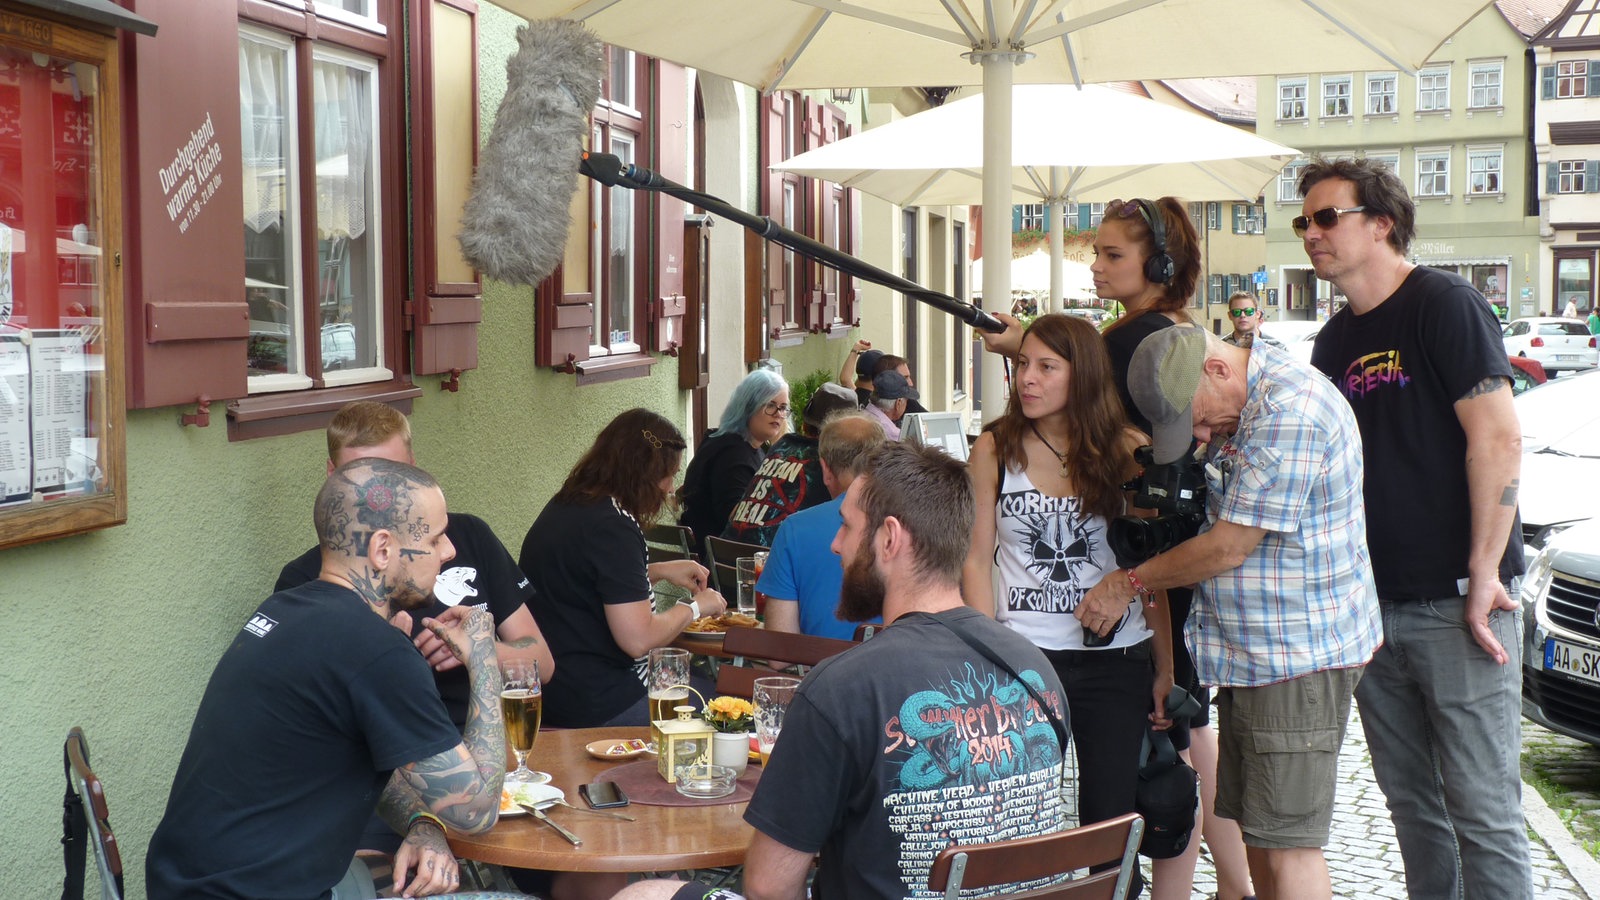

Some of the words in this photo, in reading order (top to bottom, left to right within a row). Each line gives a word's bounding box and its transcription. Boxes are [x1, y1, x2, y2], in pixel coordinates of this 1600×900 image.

[21, 20, 50, 41] 1860
[159, 111, 215, 195] Durchgehend
[166, 174, 197, 221] warme
[194, 142, 222, 186] Küche
[179, 218, 189, 234] von
[187, 200, 201, 223] 11.30
[750, 478, 772, 500] IS
[1009, 588, 1026, 609] OF
[1025, 589, 1084, 612] CONFOR
[1553, 645, 1570, 670] AA
[967, 734, 1013, 765] 2014
[883, 790, 939, 808] MACHINE
[942, 785, 975, 799] HEAD
[987, 774, 1027, 793] HEAEN
[1029, 766, 1055, 783] SHALL
[888, 814, 932, 825] CARCASS
[941, 805, 993, 820] TESTAMENT
[1002, 795, 1037, 811] BHEMOTH
[889, 823, 922, 833] TARJA
[932, 816, 985, 831] HYPOCRISY
[1009, 804, 1037, 817] ENEMY
[893, 802, 945, 815] CHILDREN
[946, 799, 961, 810] OF
[961, 795, 994, 809] BODOM
[900, 841, 947, 851] CALLEJON
[1020, 819, 1051, 833] PROJECT
[904, 832, 939, 842] WATAIN
[949, 825, 994, 838] OBITUARY
[900, 851, 933, 860] ESKIMO
[902, 868, 930, 876] LEGION
